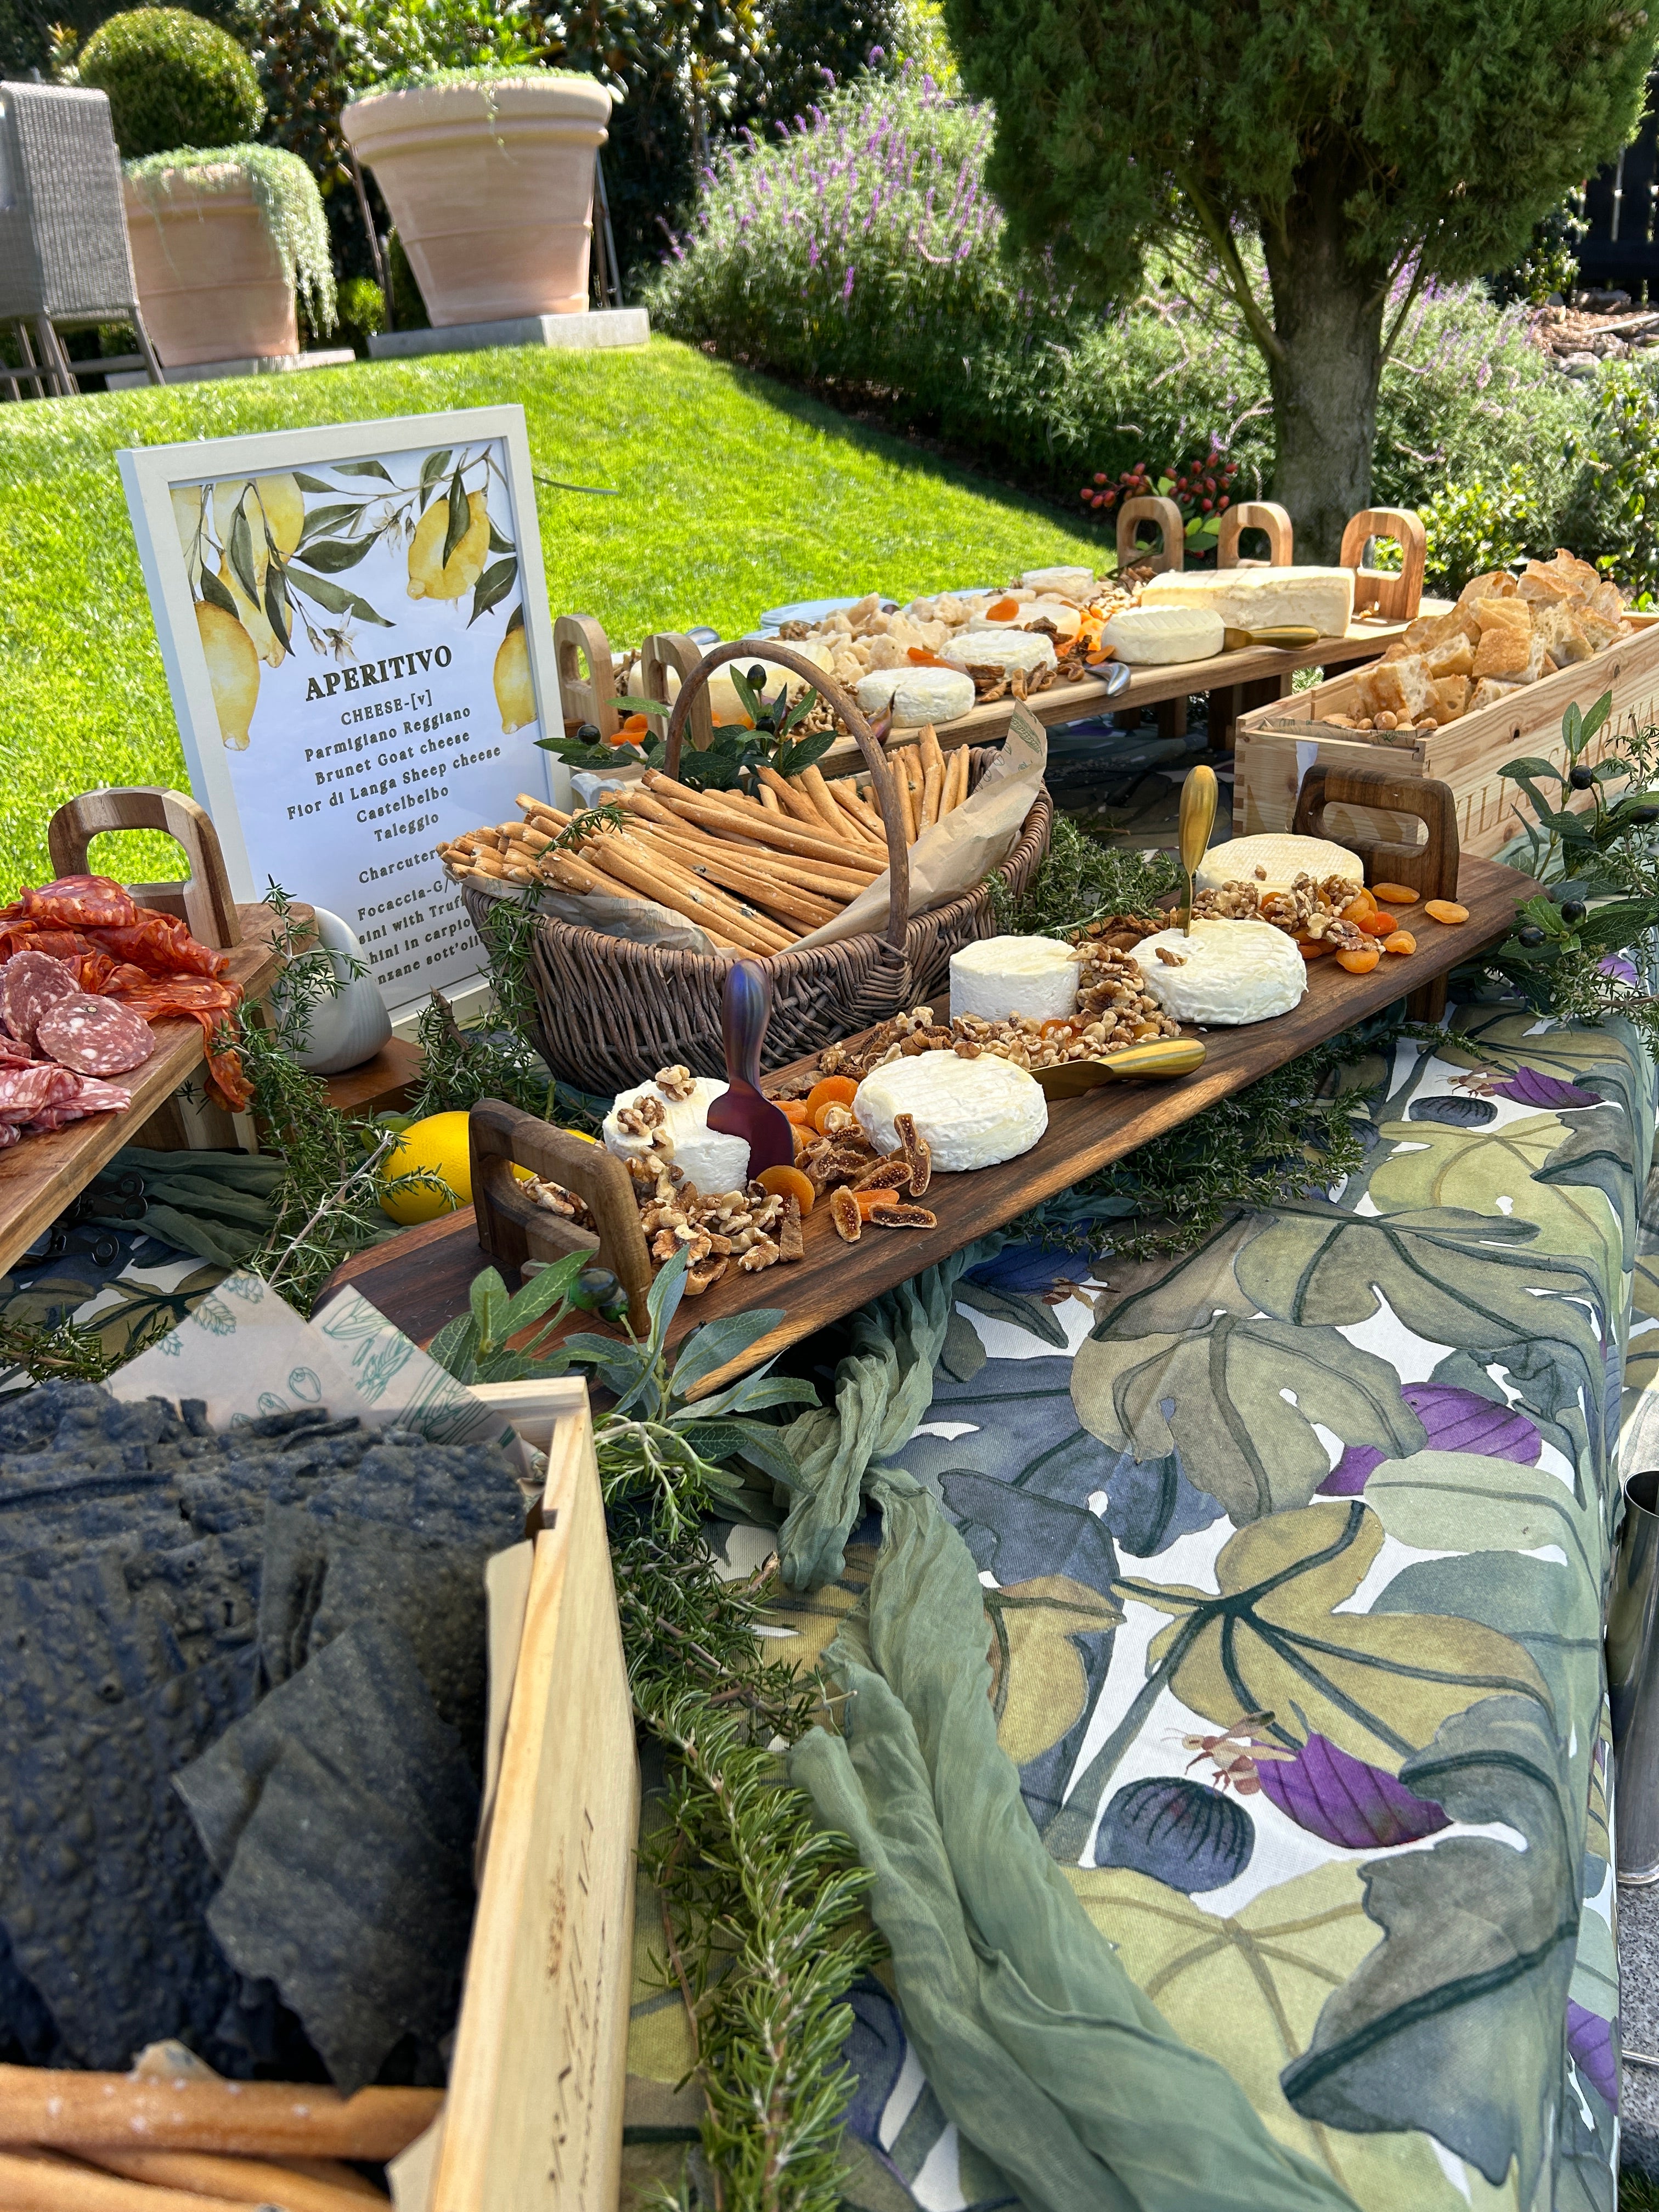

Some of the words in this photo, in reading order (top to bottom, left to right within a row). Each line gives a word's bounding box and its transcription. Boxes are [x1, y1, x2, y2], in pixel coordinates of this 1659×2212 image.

[306, 645, 452, 702] APERITIVO
[341, 689, 432, 725] CHEESE-[v]
[304, 729, 397, 762] Parmigiano
[403, 708, 470, 735] Reggiano
[315, 759, 371, 786] Brunet
[378, 747, 414, 766] Goat
[420, 732, 470, 754] cheese
[287, 800, 321, 820] Fior
[329, 792, 344, 806] di
[350, 778, 397, 800] Langa
[403, 763, 446, 784] Sheep
[453, 747, 500, 769] cheese
[356, 787, 448, 822] Castelbelbo
[374, 814, 438, 842] Taleggio
[359, 850, 439, 884] Charcuter
[358, 925, 387, 945] sini
[392, 911, 424, 932] with
[367, 944, 399, 965] hini
[405, 939, 419, 951] in
[425, 919, 470, 943] carpio
[376, 961, 420, 985] nzane
[426, 935, 481, 966] sott'oli
